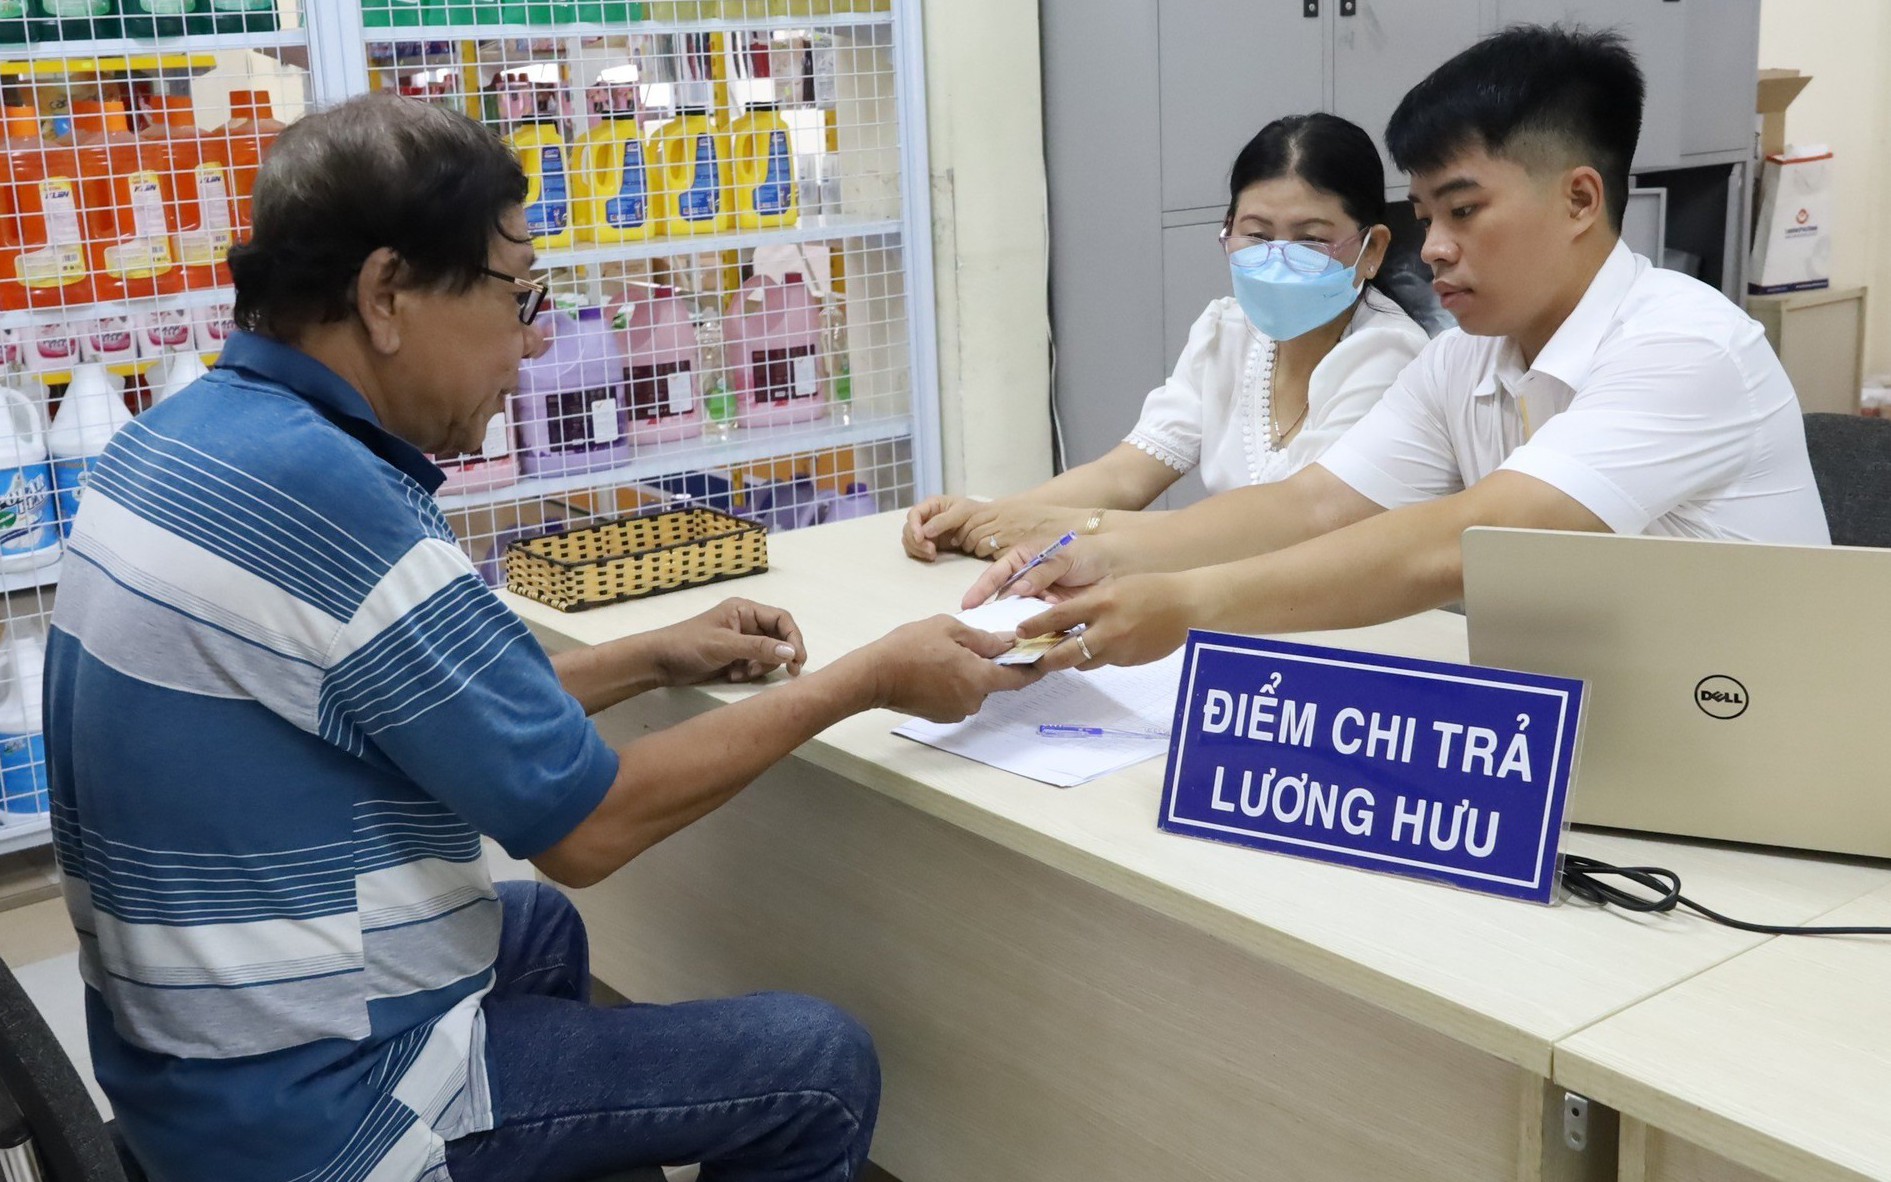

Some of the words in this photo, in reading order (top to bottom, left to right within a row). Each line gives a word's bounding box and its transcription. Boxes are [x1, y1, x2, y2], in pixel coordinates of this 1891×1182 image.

[1202, 672, 1317, 748] ĐIỂM
[1332, 707, 1417, 763] CHI
[1432, 713, 1532, 783] TRẢ
[1701, 690, 1743, 704] DELL
[1211, 766, 1375, 836] LƯƠNG
[1391, 796, 1500, 858] HƯU
